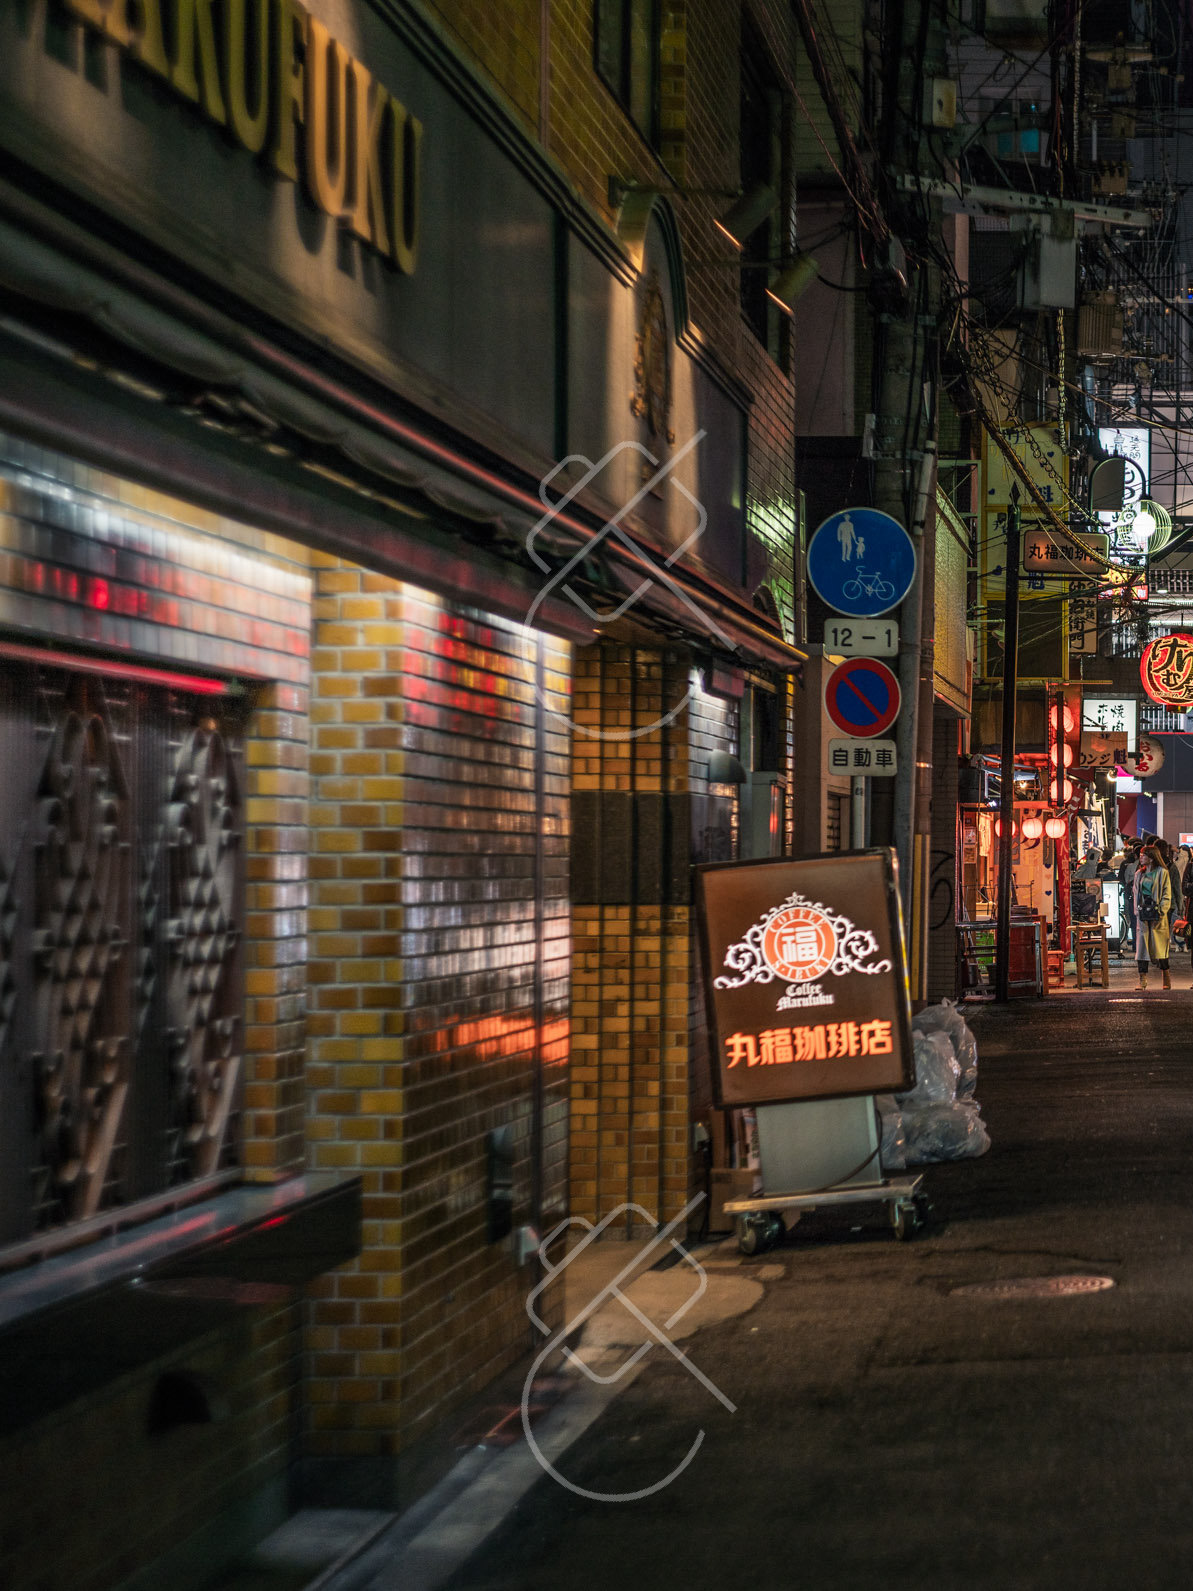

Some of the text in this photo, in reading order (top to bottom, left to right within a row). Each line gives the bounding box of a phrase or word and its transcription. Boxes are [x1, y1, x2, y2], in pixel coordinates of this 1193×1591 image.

[832, 747, 894, 769] 自動車
[781, 925, 819, 963] 福
[724, 1018, 894, 1069] 丸福珈琲店
